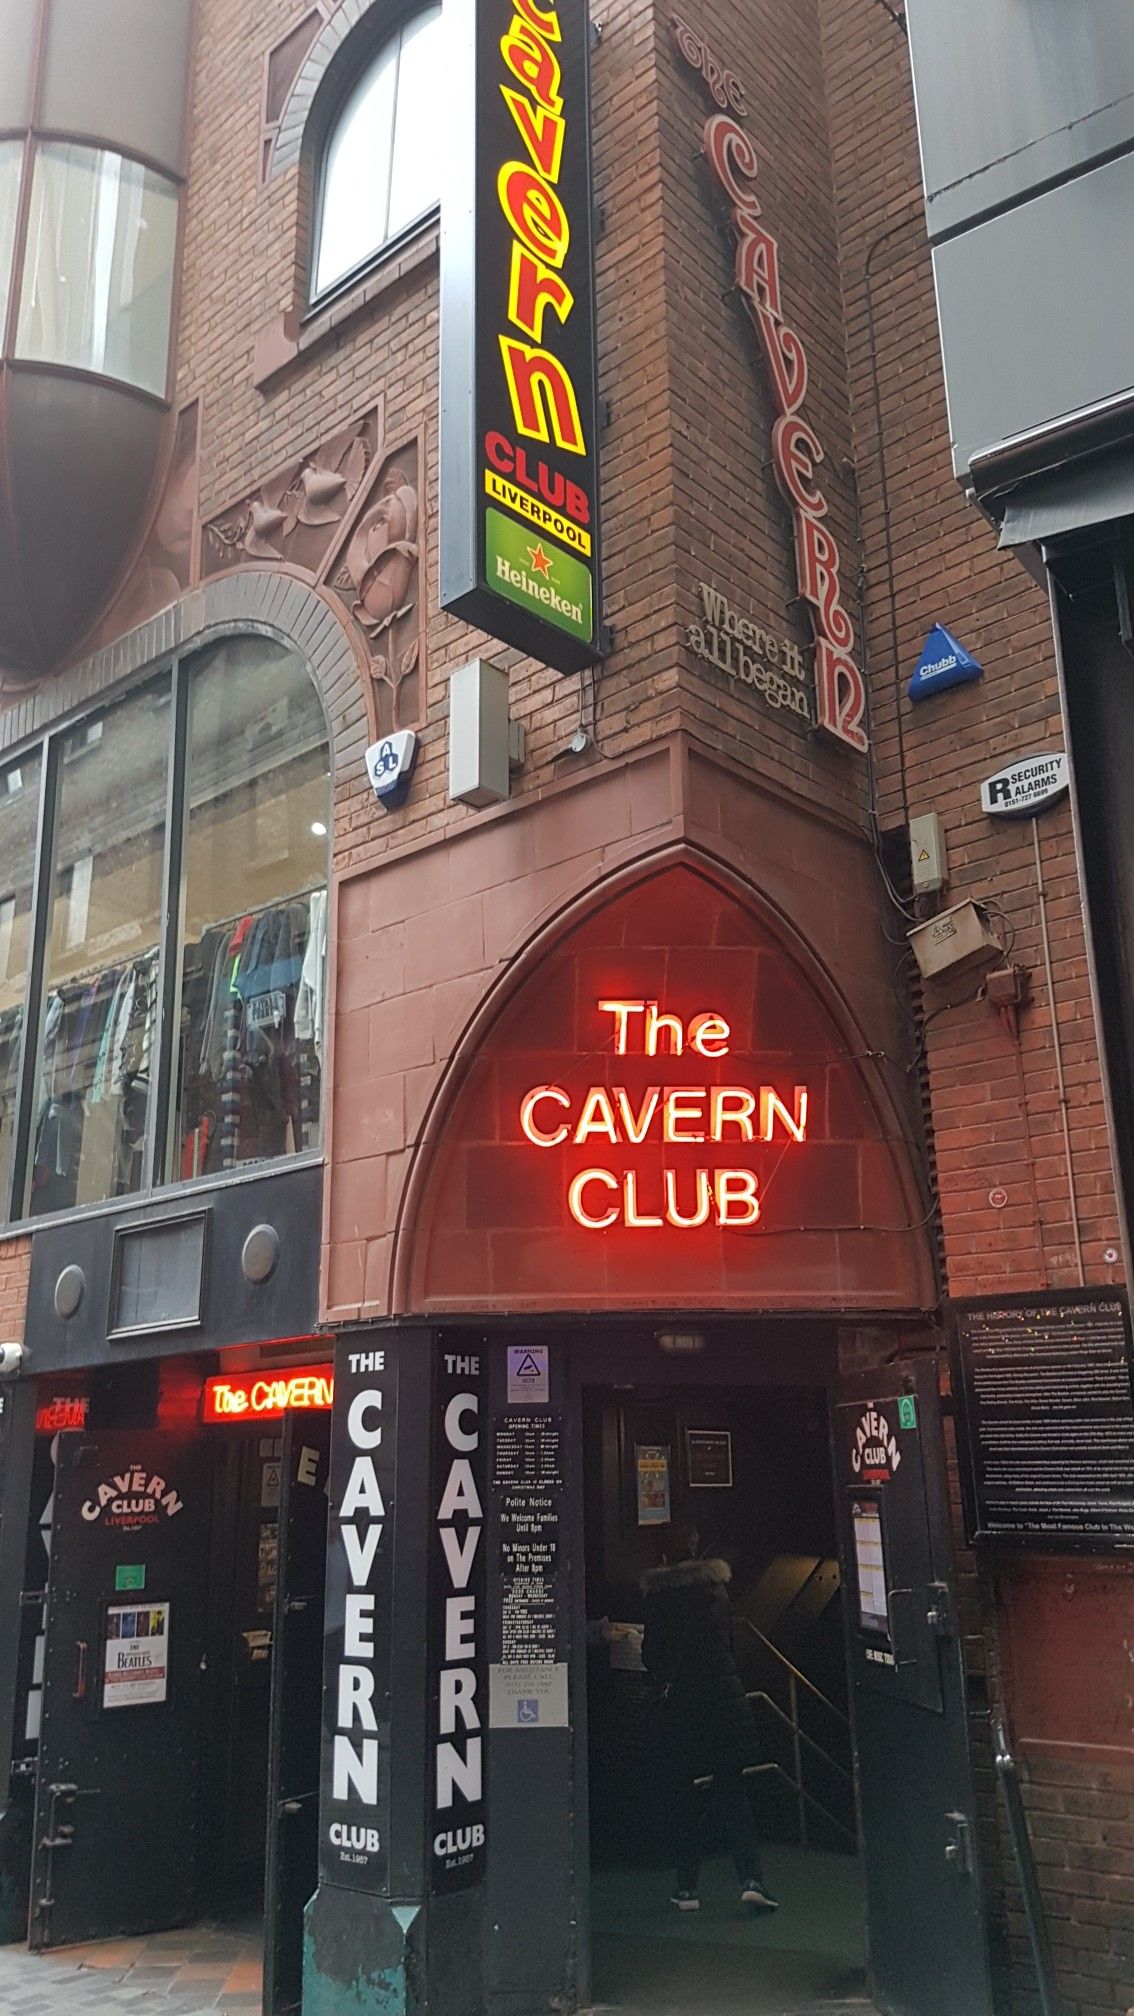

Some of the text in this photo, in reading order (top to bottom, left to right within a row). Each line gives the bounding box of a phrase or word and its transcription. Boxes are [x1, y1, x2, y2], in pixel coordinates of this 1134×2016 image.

[485, 430, 590, 525] CLUB
[491, 477, 588, 551] LIVERPOOL
[495, 555, 584, 625] Heineken
[685, 624, 811, 719] all began
[919, 654, 958, 677] Chubb
[988, 758, 1063, 805] R SECURITY
[1014, 773, 1058, 797] ALARMS
[597, 999, 731, 1058] The
[519, 1084, 808, 1148] CAVERN
[567, 1167, 762, 1230] CLUB
[348, 1351, 385, 1374] THE
[444, 1354, 480, 1375] THE
[213, 1376, 334, 1413] The CAVERN
[852, 1411, 901, 1472] CAVERN
[864, 1448, 887, 1465] CLUB
[81, 1471, 184, 1521] CAVERN
[111, 1498, 156, 1514] CLUB
[505, 1497, 552, 1507] Polite Notice
[333, 1389, 386, 1805] CAVERN
[436, 1392, 484, 1809] CAVERN
[329, 1822, 380, 1853] CLUB
[434, 1823, 485, 1856] CLUB
